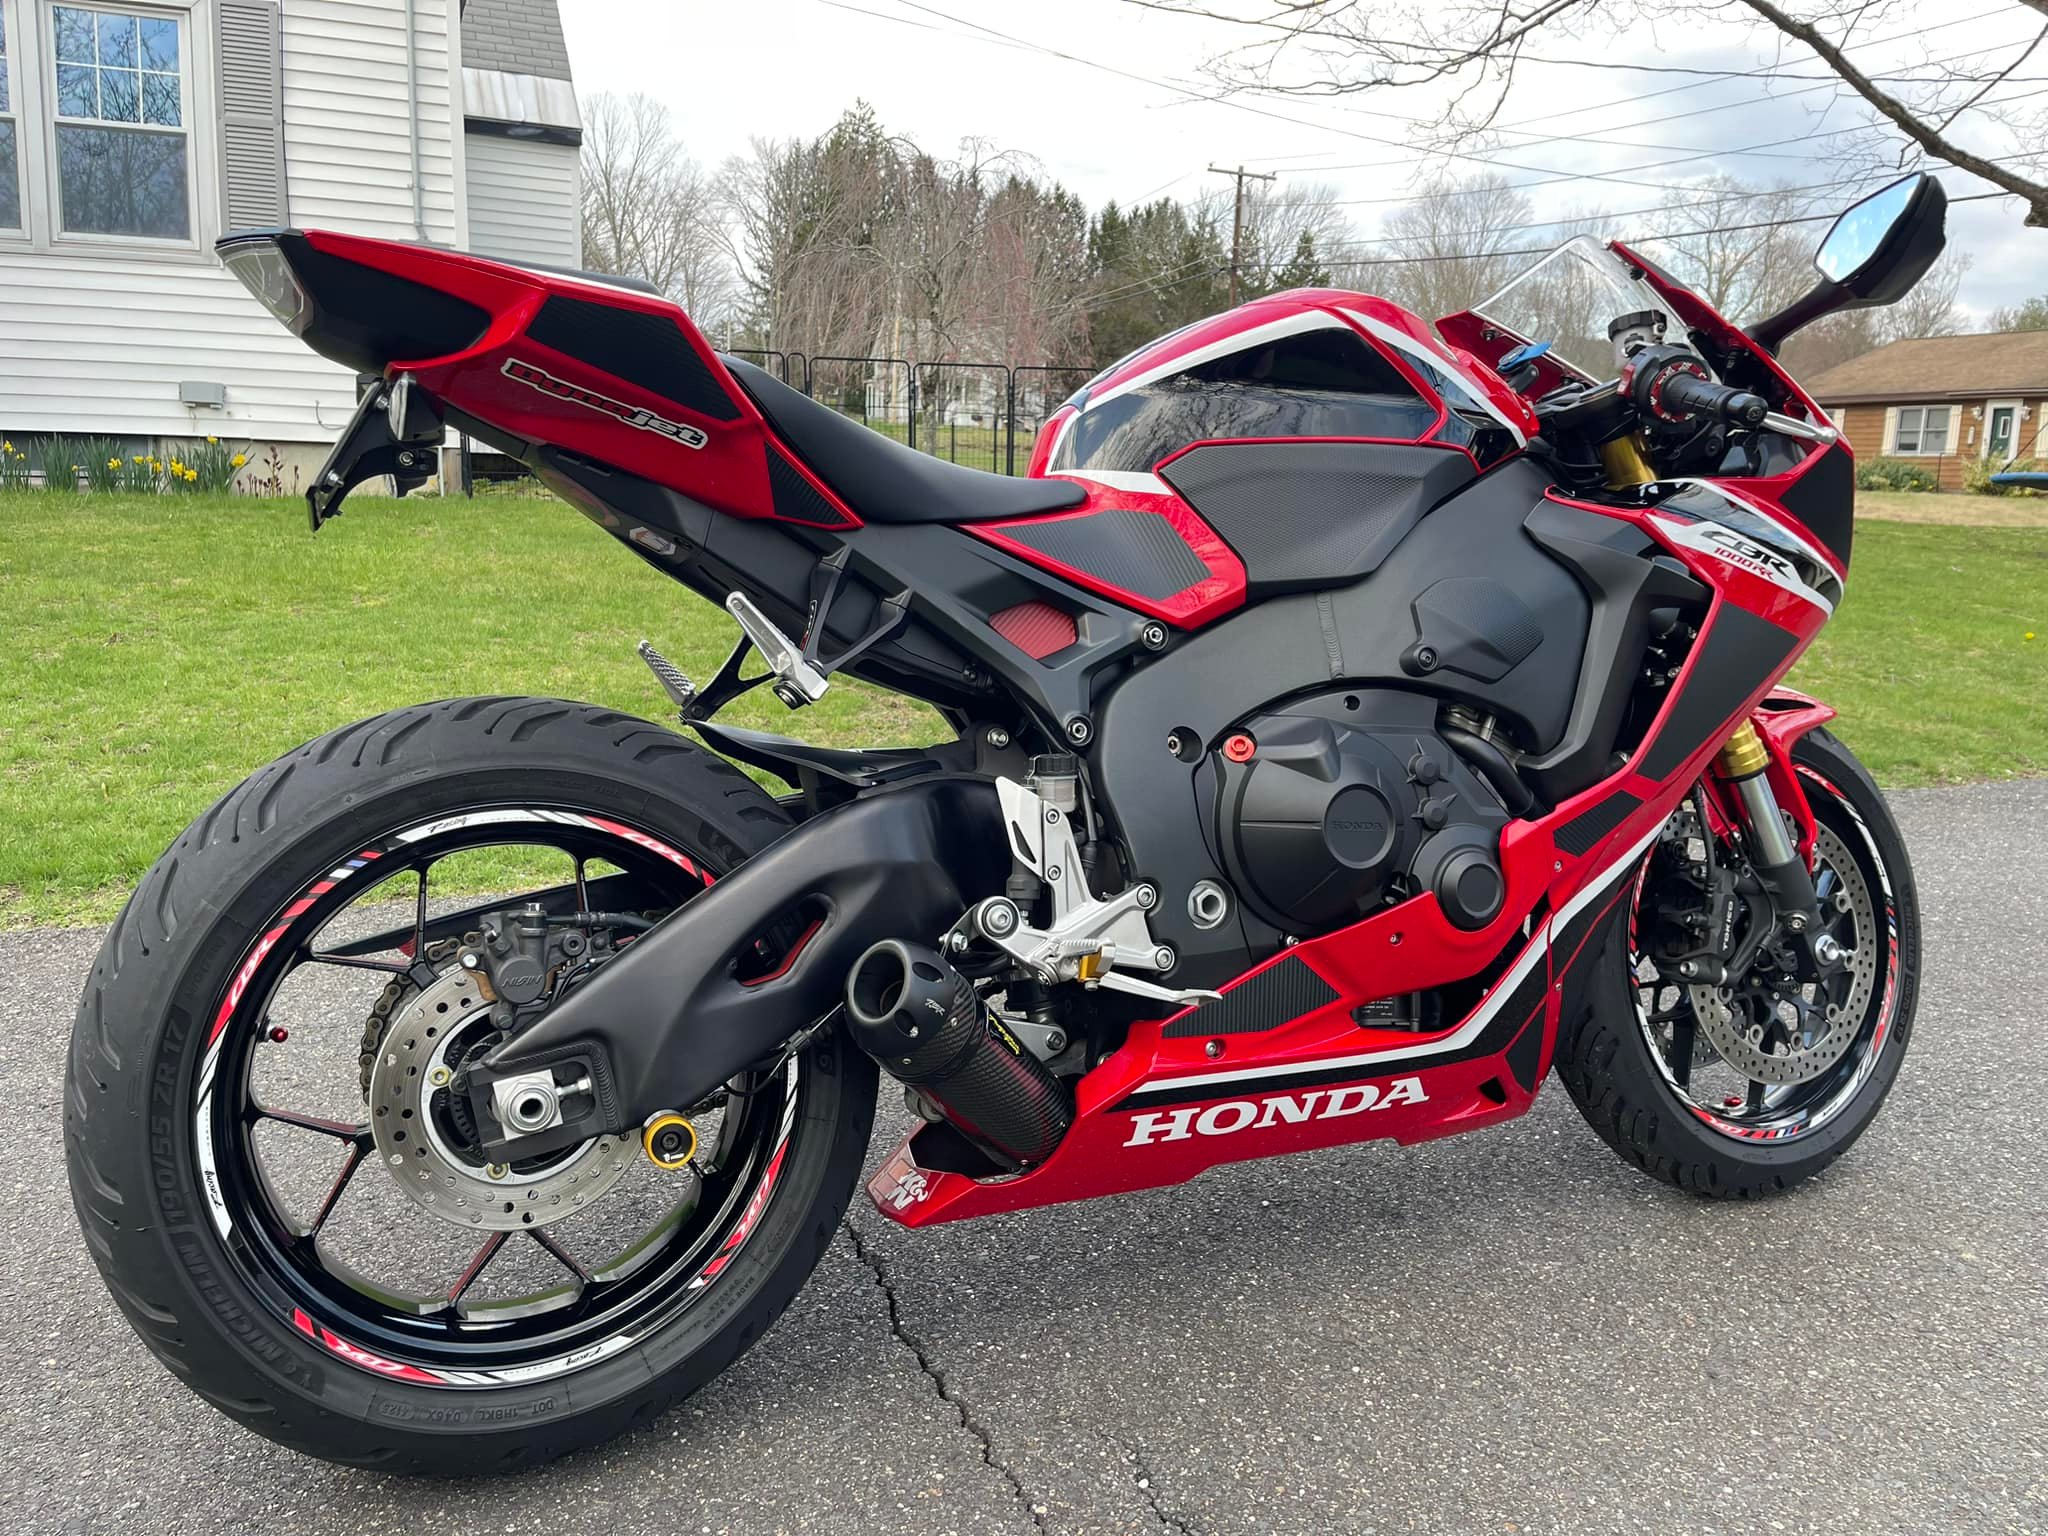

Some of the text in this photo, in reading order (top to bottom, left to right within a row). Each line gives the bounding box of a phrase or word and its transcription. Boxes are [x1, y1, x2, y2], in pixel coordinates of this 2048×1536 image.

[1701, 530, 1791, 579] CBR
[1714, 547, 1774, 581] 1000RR
[1330, 820, 1385, 831] HONDA
[622, 831, 684, 866] CBR
[1722, 900, 1734, 952] TOKICO
[231, 938, 275, 1006] CBR
[152, 1016, 186, 1224] 190/55 ZR 17
[1122, 1076, 1430, 1147] HONDA
[203, 1169, 222, 1209] Racing
[885, 1169, 928, 1210] K&N
[178, 1232, 286, 1368] MICHELIN
[334, 1341, 404, 1371] CBR
[531, 1400, 554, 1415] DOT
